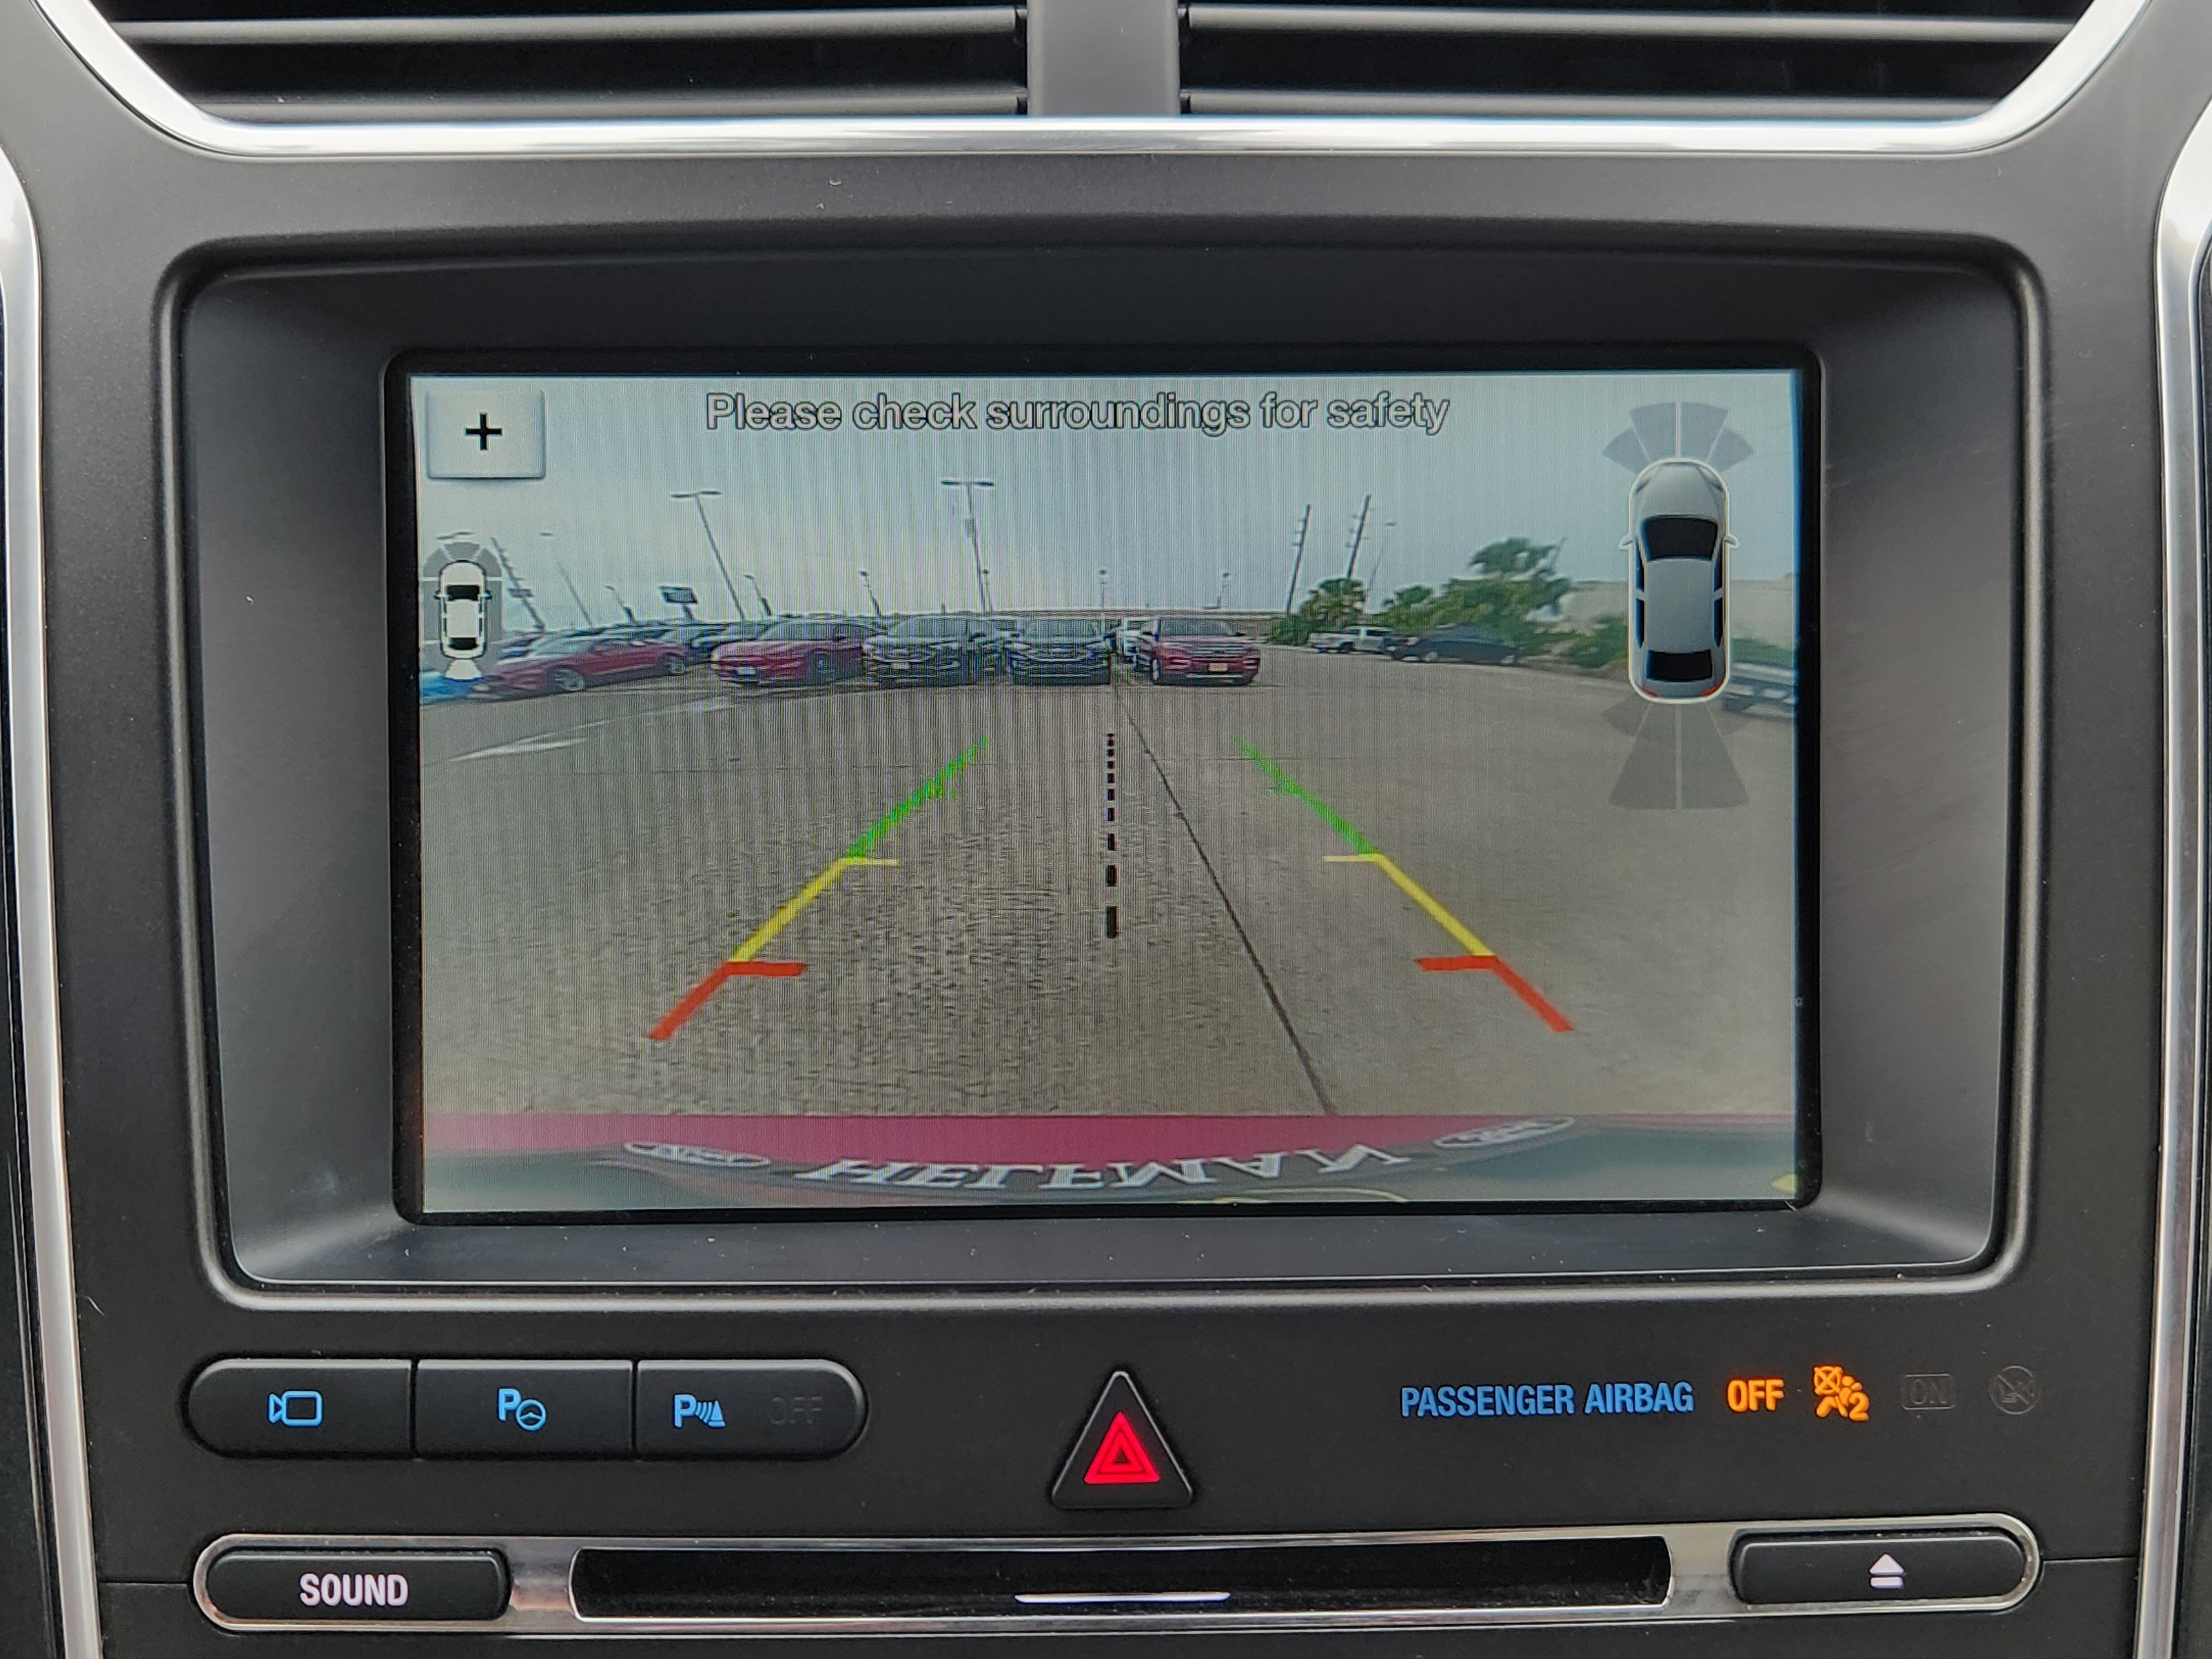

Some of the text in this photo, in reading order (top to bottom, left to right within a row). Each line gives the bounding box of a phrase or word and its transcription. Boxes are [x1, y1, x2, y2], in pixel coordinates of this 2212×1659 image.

[706, 392, 1451, 436] Please check surroundings for safety
[1400, 1377, 1785, 1418] PASSENGER AIRBAG OFF
[299, 1573, 409, 1606] SOUND
